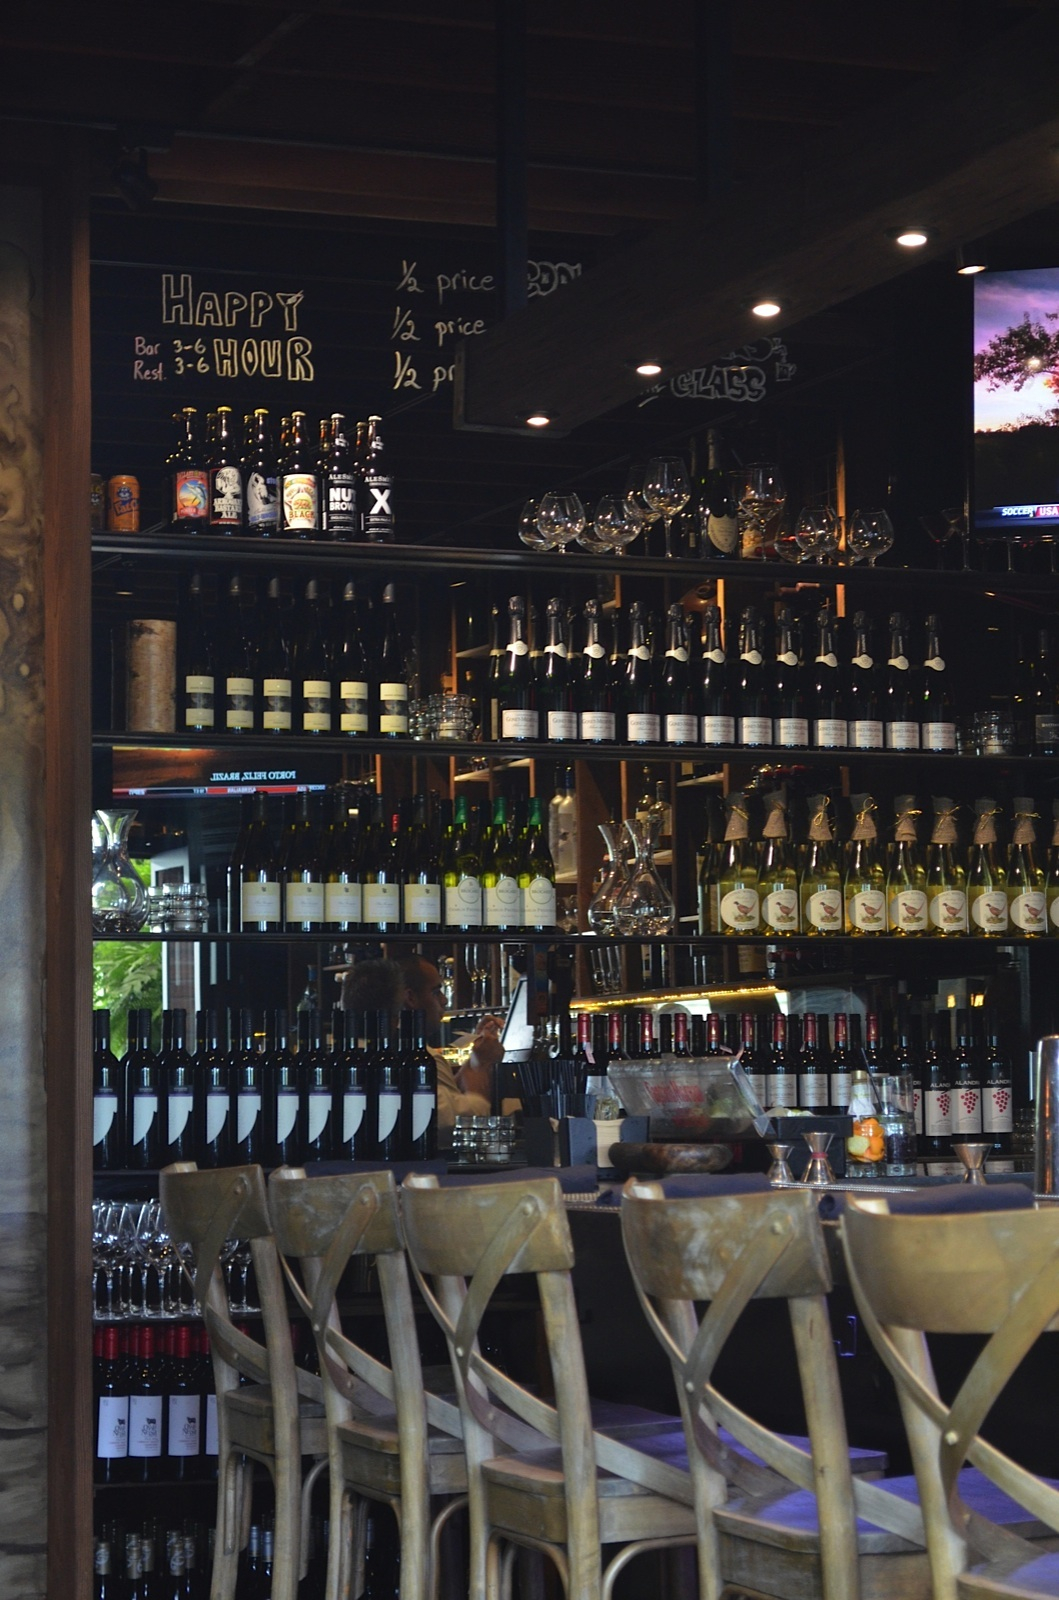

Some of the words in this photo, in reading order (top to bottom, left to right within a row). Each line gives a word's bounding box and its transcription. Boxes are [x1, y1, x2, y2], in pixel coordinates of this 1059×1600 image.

[162, 274, 304, 331] HAPPY
[437, 270, 495, 305] price
[134, 336, 160, 355] Bar
[173, 338, 206, 354] 3-6
[435, 317, 487, 347] price
[175, 357, 210, 374] 3-6
[213, 336, 314, 381] HOUR
[671, 365, 766, 402] GLASS
[369, 488, 392, 515] X
[1002, 507, 1034, 516] SOCCER
[1040, 507, 1059, 516] USA
